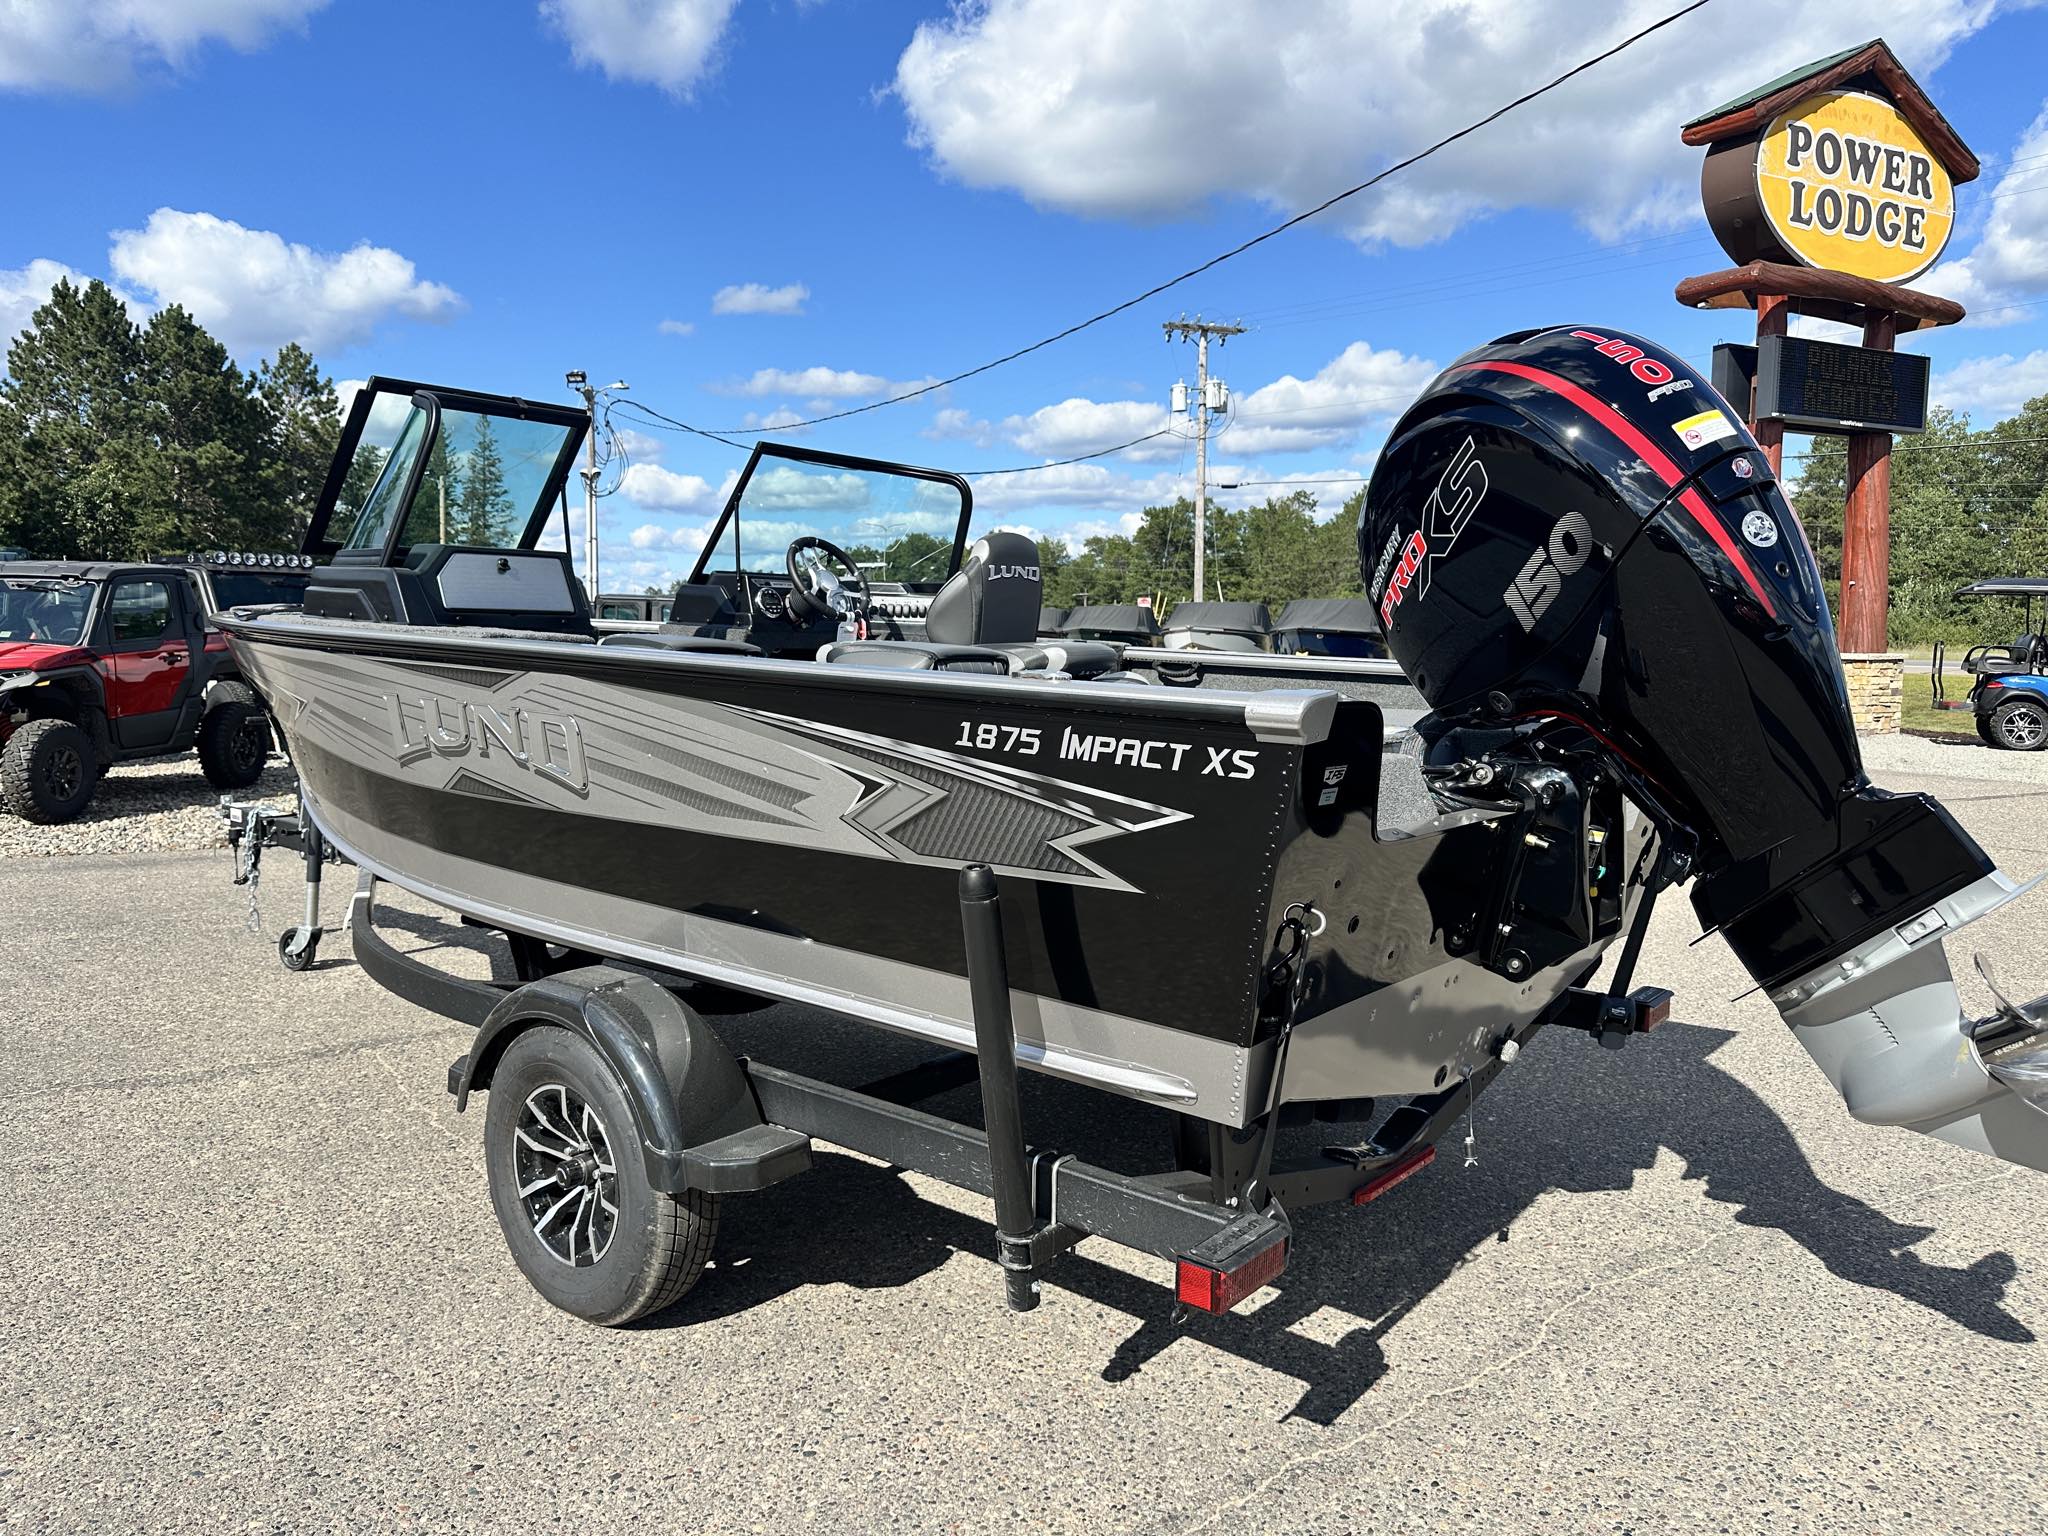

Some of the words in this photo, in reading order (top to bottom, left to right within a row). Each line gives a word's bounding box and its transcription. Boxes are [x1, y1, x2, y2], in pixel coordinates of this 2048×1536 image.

[1786, 122, 1932, 200] POWER
[1789, 181, 1926, 249] LODGE
[1569, 330, 1674, 385] 150
[1647, 379, 1694, 403] PRO
[1399, 435, 1488, 601] XS
[987, 564, 1040, 582] LUND
[1369, 523, 1402, 602] MERCURY
[1380, 529, 1427, 630] PRO
[1503, 511, 1593, 634] 150
[383, 691, 590, 795] LUND
[954, 721, 1042, 756] 1875
[1059, 725, 1192, 772] IMPACT
[1201, 745, 1259, 780] XS
